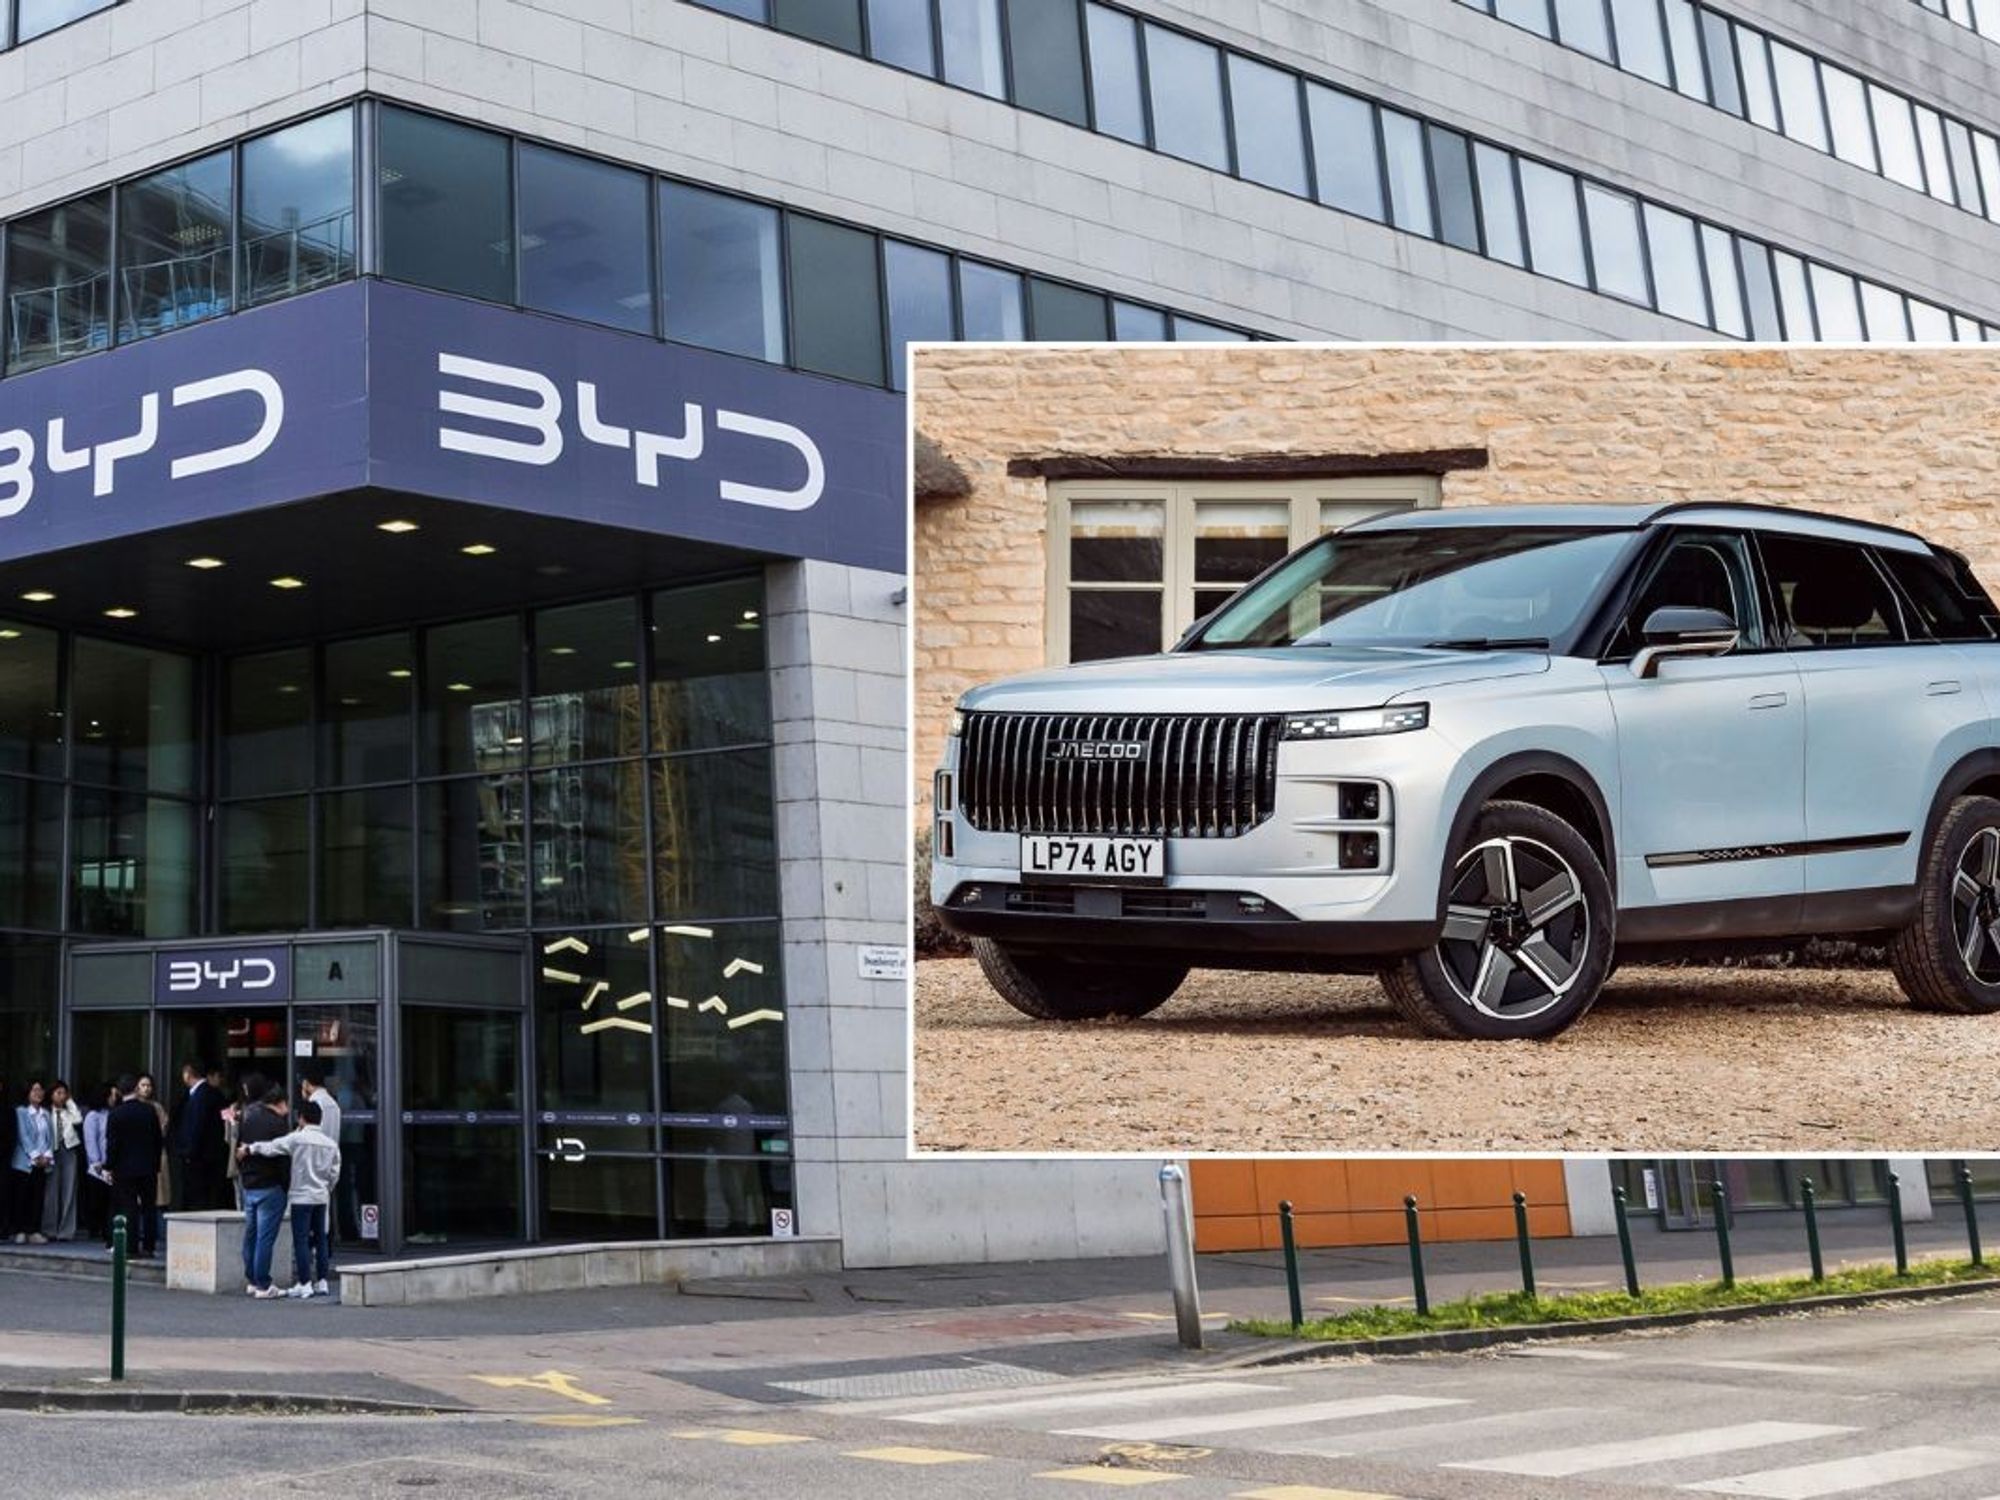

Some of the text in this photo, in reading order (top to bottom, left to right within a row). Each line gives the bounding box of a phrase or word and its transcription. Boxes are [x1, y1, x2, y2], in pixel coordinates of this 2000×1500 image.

[438, 352, 826, 512] BYD
[1050, 742, 1142, 759] JAECOO
[1032, 841, 1152, 873] LP74 AGY
[169, 957, 277, 991] BYD
[327, 961, 343, 981] A
